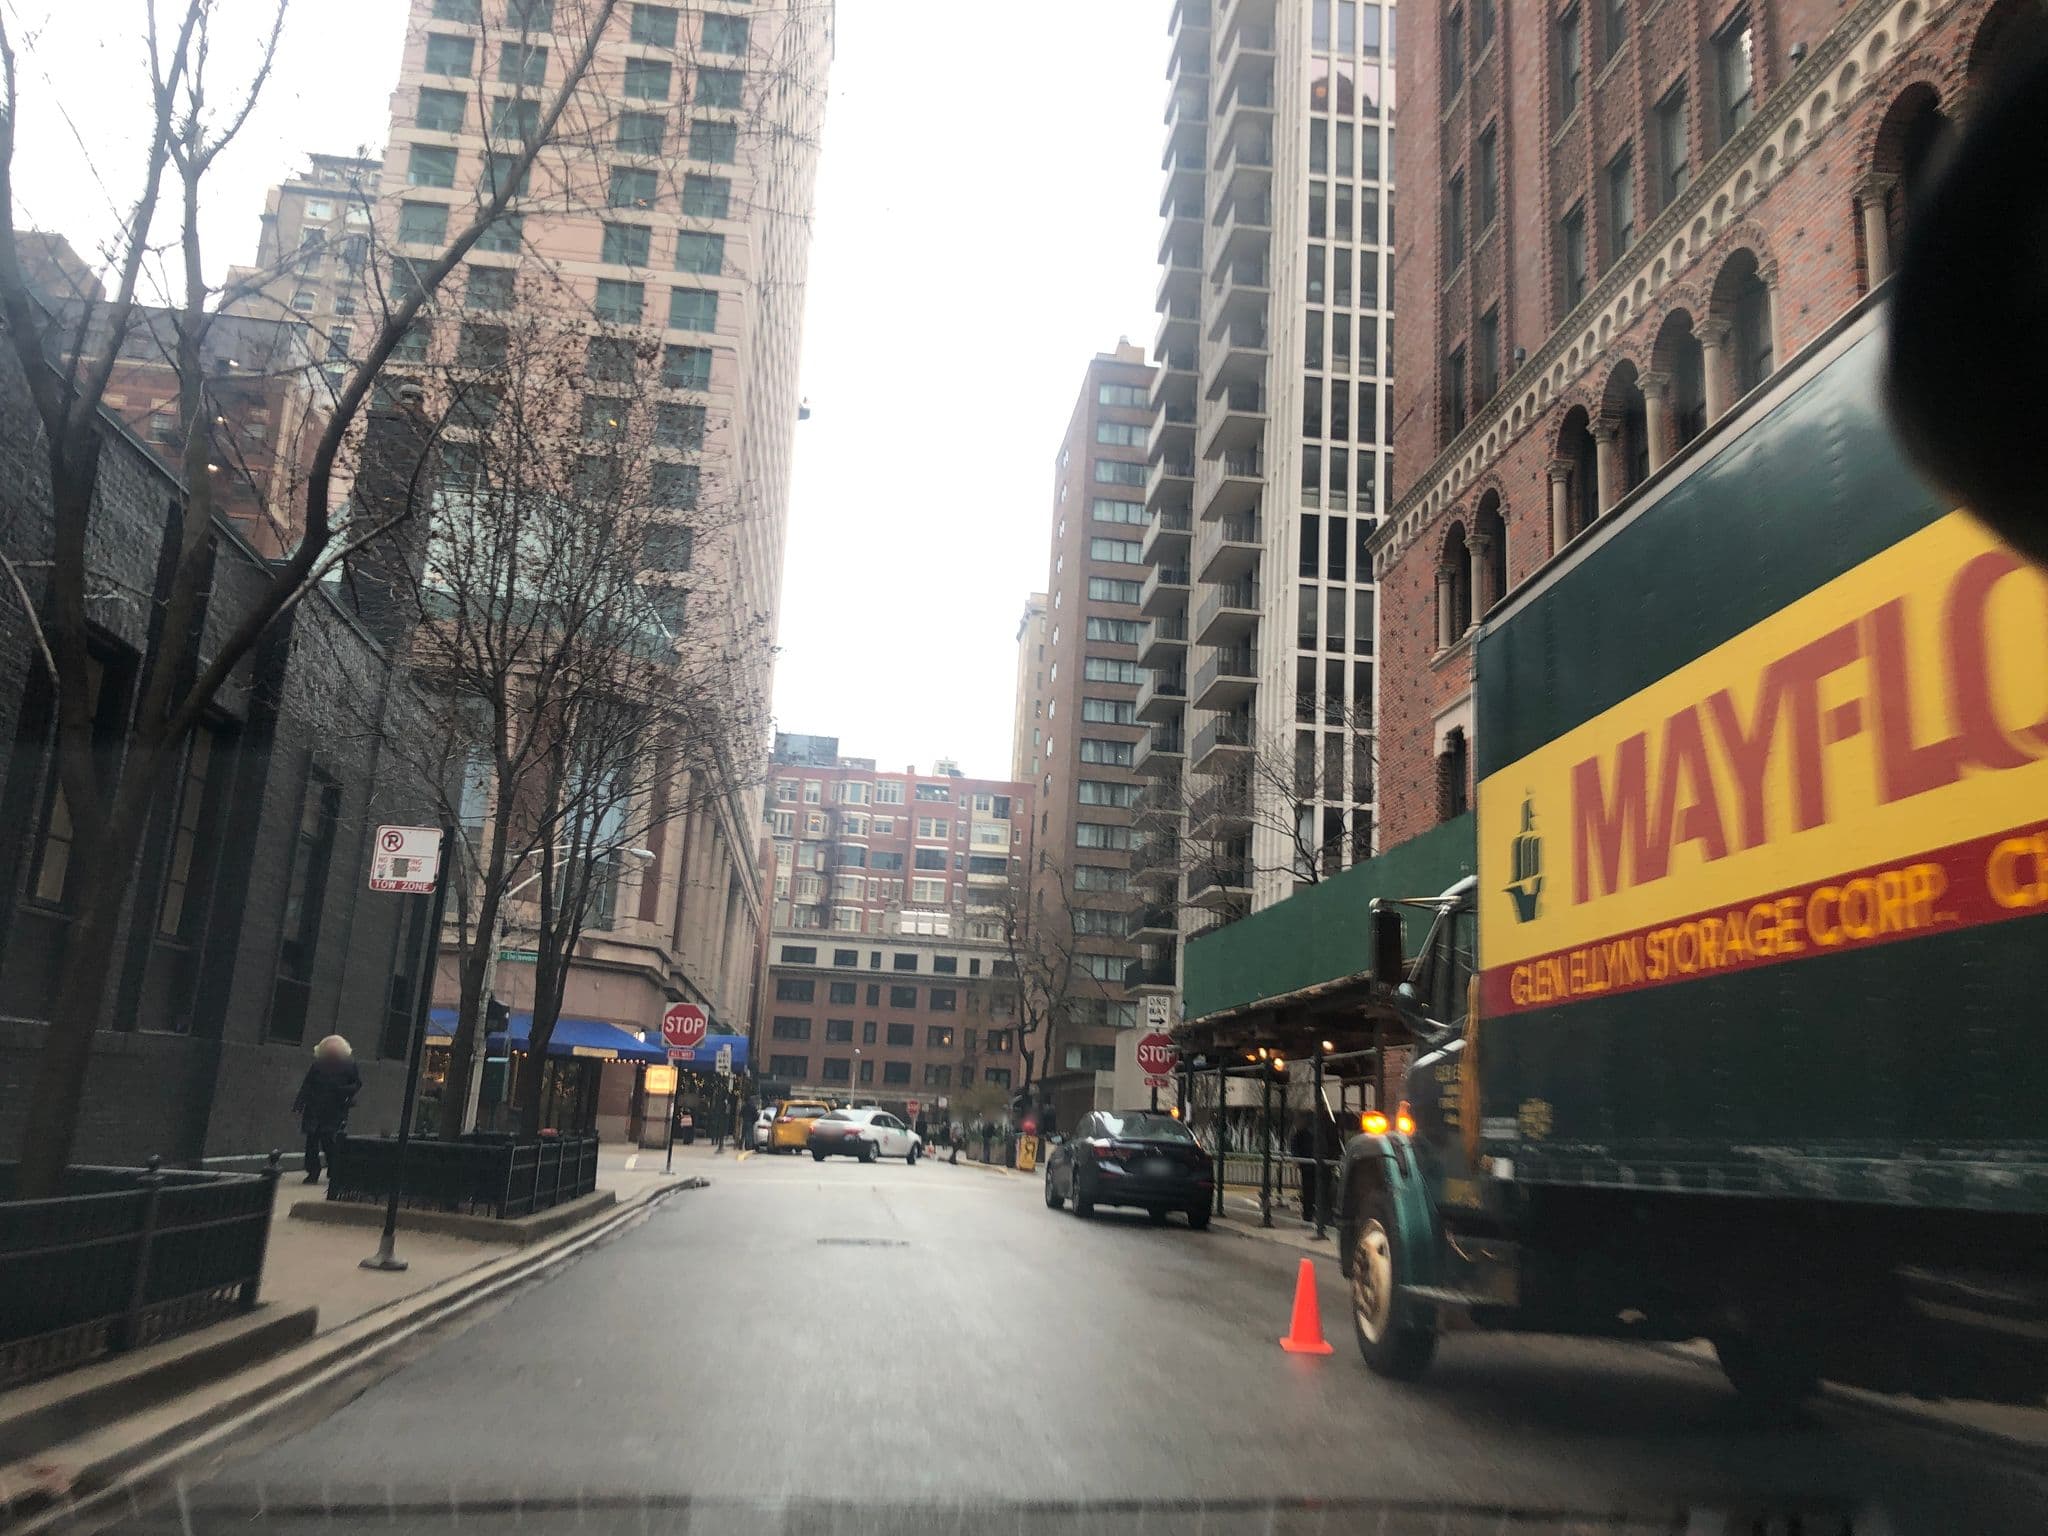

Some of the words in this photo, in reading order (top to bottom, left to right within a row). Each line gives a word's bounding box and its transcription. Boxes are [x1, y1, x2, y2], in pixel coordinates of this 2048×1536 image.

[375, 880, 397, 889] TOW
[401, 881, 430, 891] ZONE
[1511, 955, 1570, 1006] GLEN
[1569, 936, 1647, 995] ELLYN
[1645, 896, 1806, 981] STORAGE
[1149, 997, 1168, 1007] ONE
[665, 1016, 704, 1035] STOP
